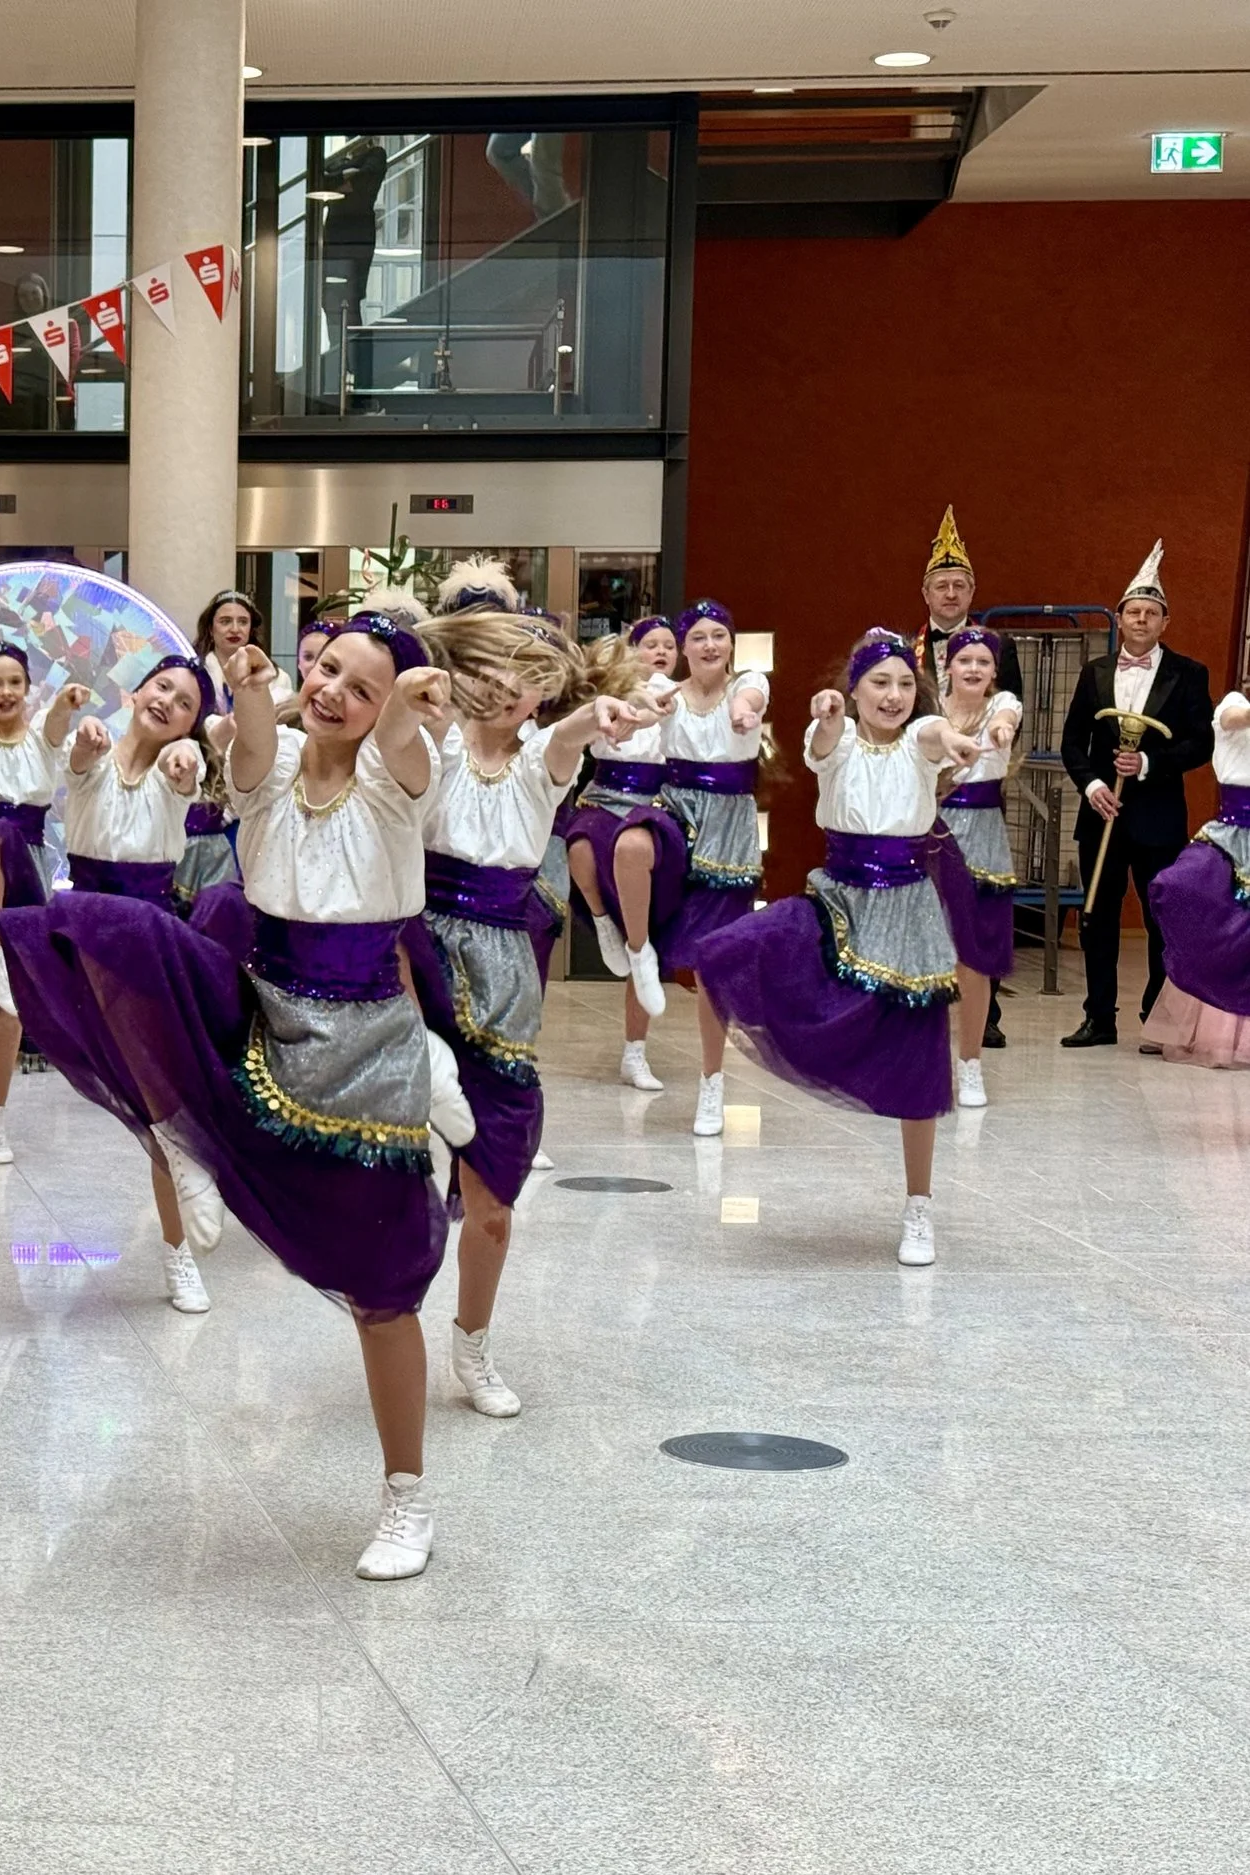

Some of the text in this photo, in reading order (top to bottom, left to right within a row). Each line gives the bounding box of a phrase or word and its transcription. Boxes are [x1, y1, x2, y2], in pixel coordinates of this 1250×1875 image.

[198, 256, 220, 285] S
[147, 277, 169, 304] S
[96, 301, 120, 330] S
[43, 320, 65, 347] S
